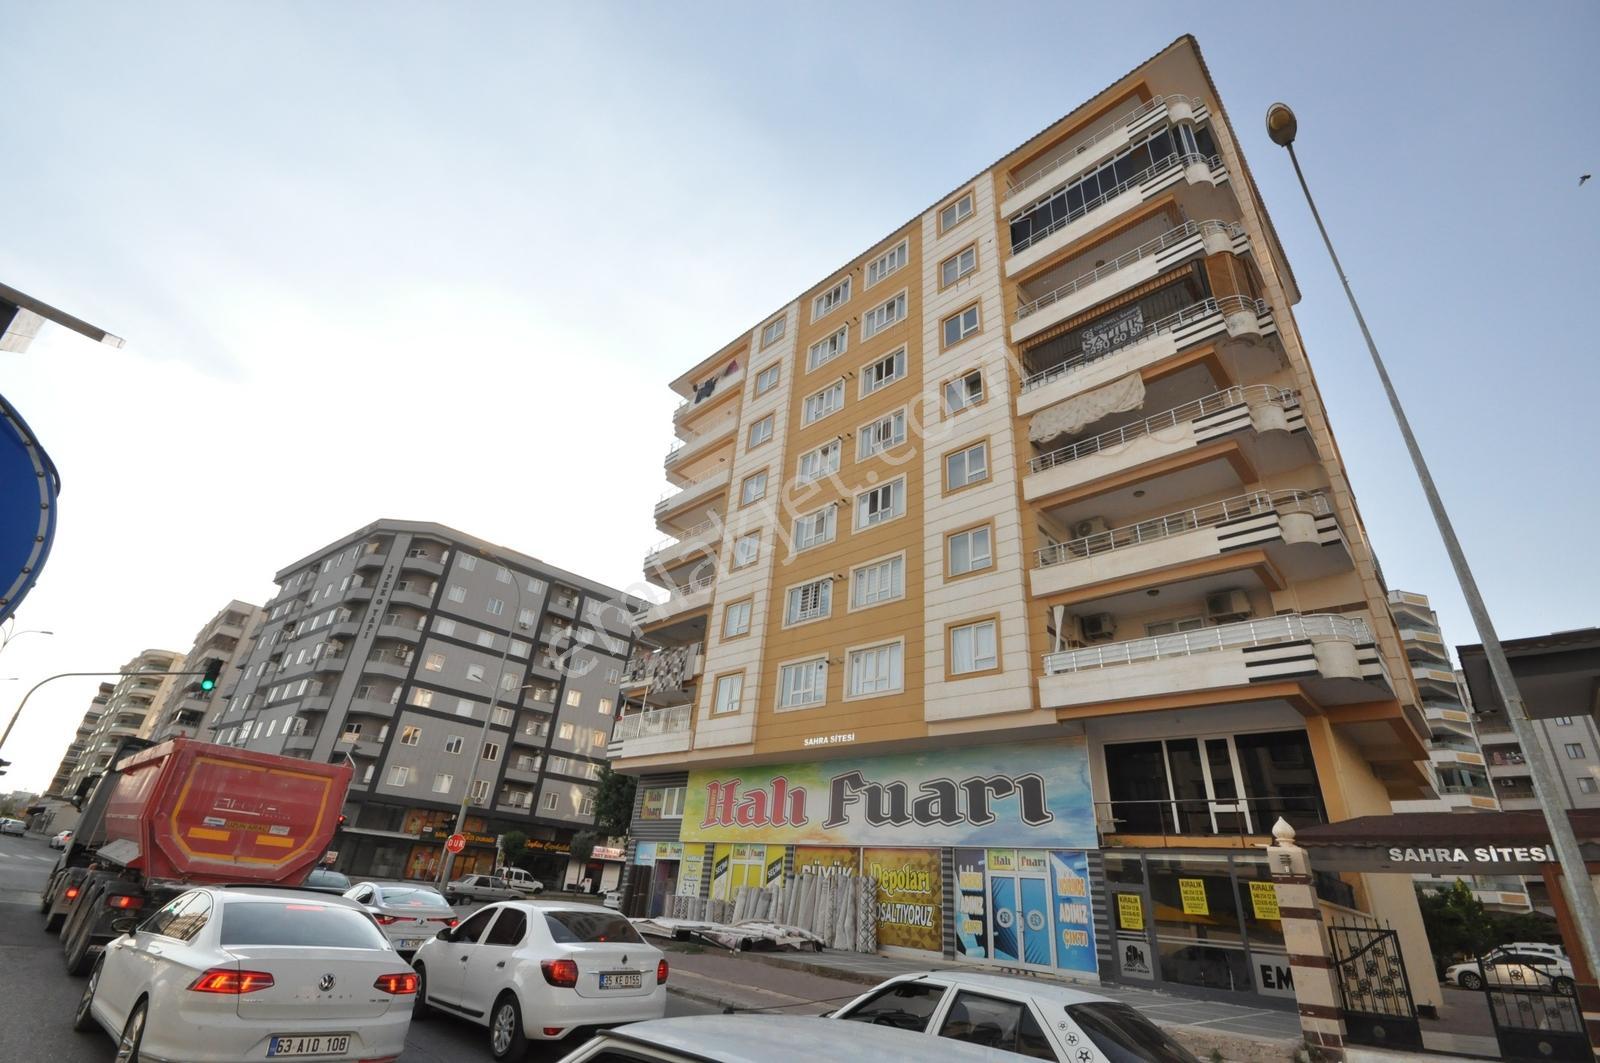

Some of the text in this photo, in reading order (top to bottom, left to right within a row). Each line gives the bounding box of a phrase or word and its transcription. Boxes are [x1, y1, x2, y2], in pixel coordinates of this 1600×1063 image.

[1113, 333, 1127, 344] 60
[1130, 324, 1143, 337] 80
[804, 732, 855, 746] SAHRA SİTESİ
[700, 776, 808, 829] Halı
[822, 770, 1053, 829] Fuarı
[448, 839, 464, 848] DUR
[993, 855, 1046, 867] Halı Fuarı
[1389, 845, 1555, 863] SAHRA SİTESİ
[871, 863, 930, 897] Depoları
[1059, 903, 1088, 924] ADIMIZ
[615, 975, 623, 985] KE
[276, 1037, 346, 1053] 63 AID 108
